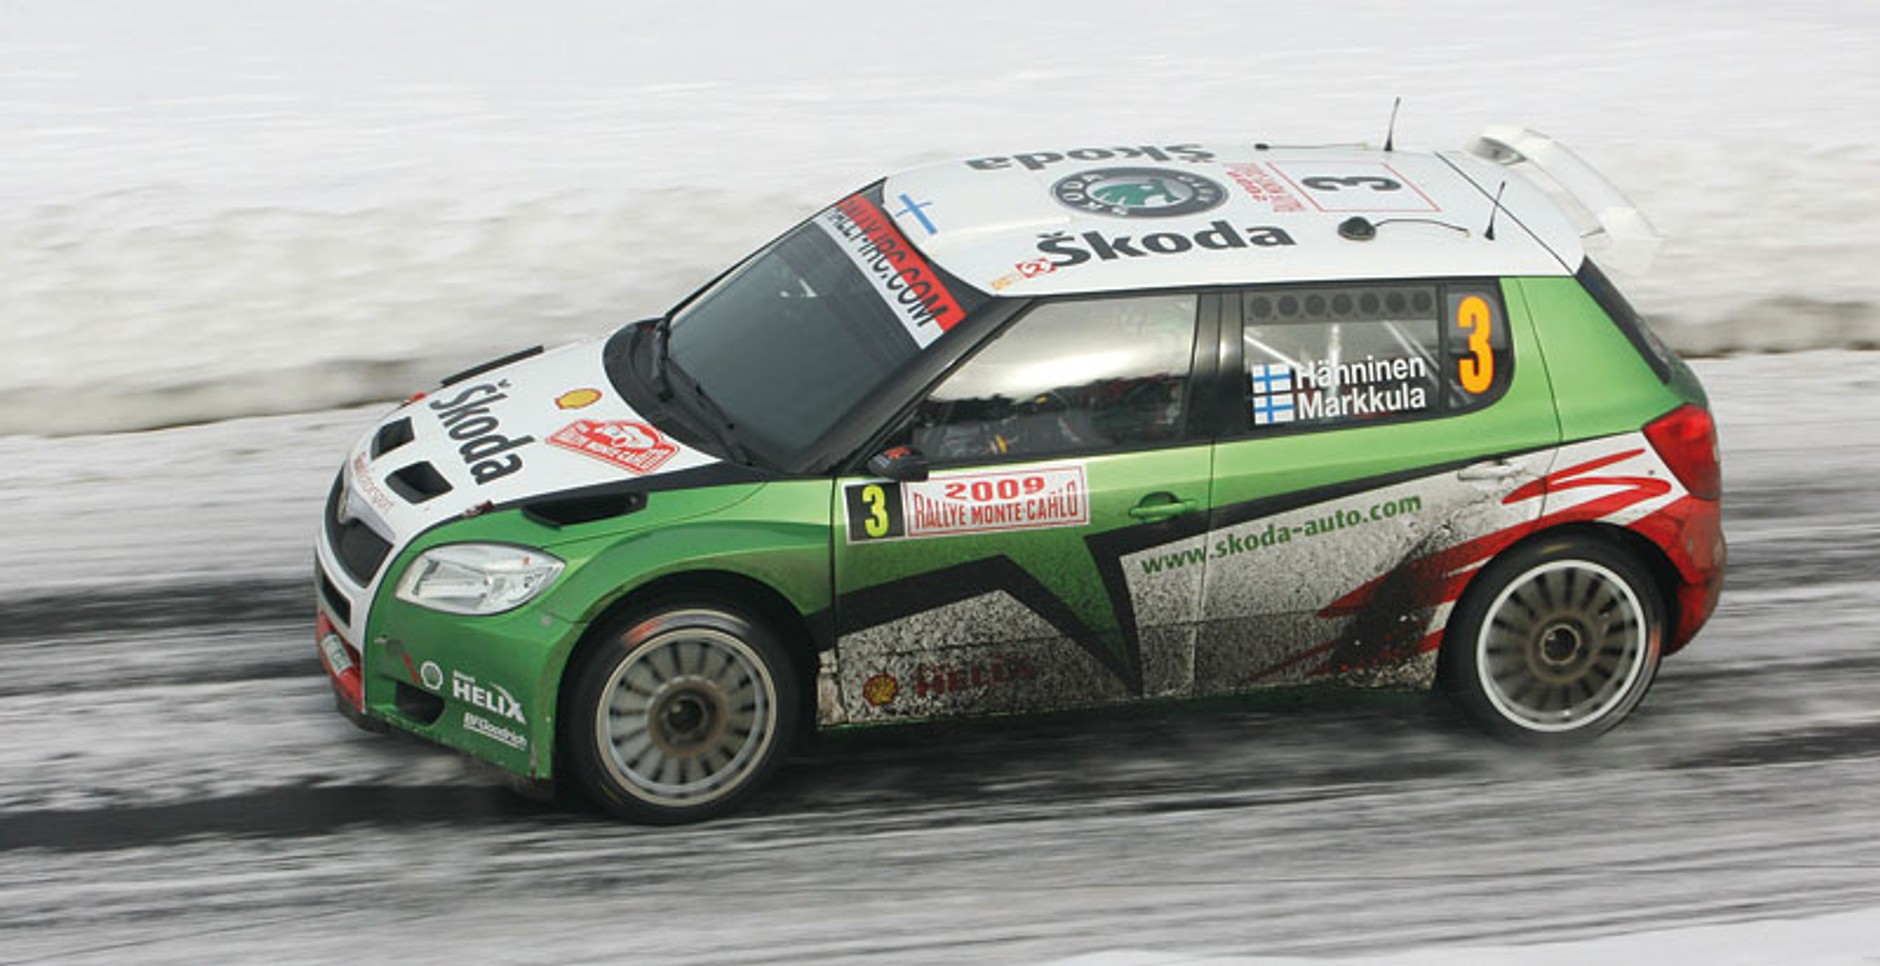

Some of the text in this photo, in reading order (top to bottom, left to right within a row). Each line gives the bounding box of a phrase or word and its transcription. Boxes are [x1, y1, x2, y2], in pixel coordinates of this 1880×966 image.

[1301, 175, 1402, 193] 3
[1036, 220, 1297, 267] Škoda
[1457, 295, 1494, 394] 3
[1296, 354, 1426, 389] Hänninen
[1298, 382, 1426, 419] Markkula
[429, 379, 535, 485] Škoda
[862, 484, 889, 537] 3
[914, 492, 966, 529] RALLYE
[945, 476, 1045, 502] 2009
[1140, 495, 1423, 575] www.skoda-auto.com
[452, 679, 528, 726] HELIX
